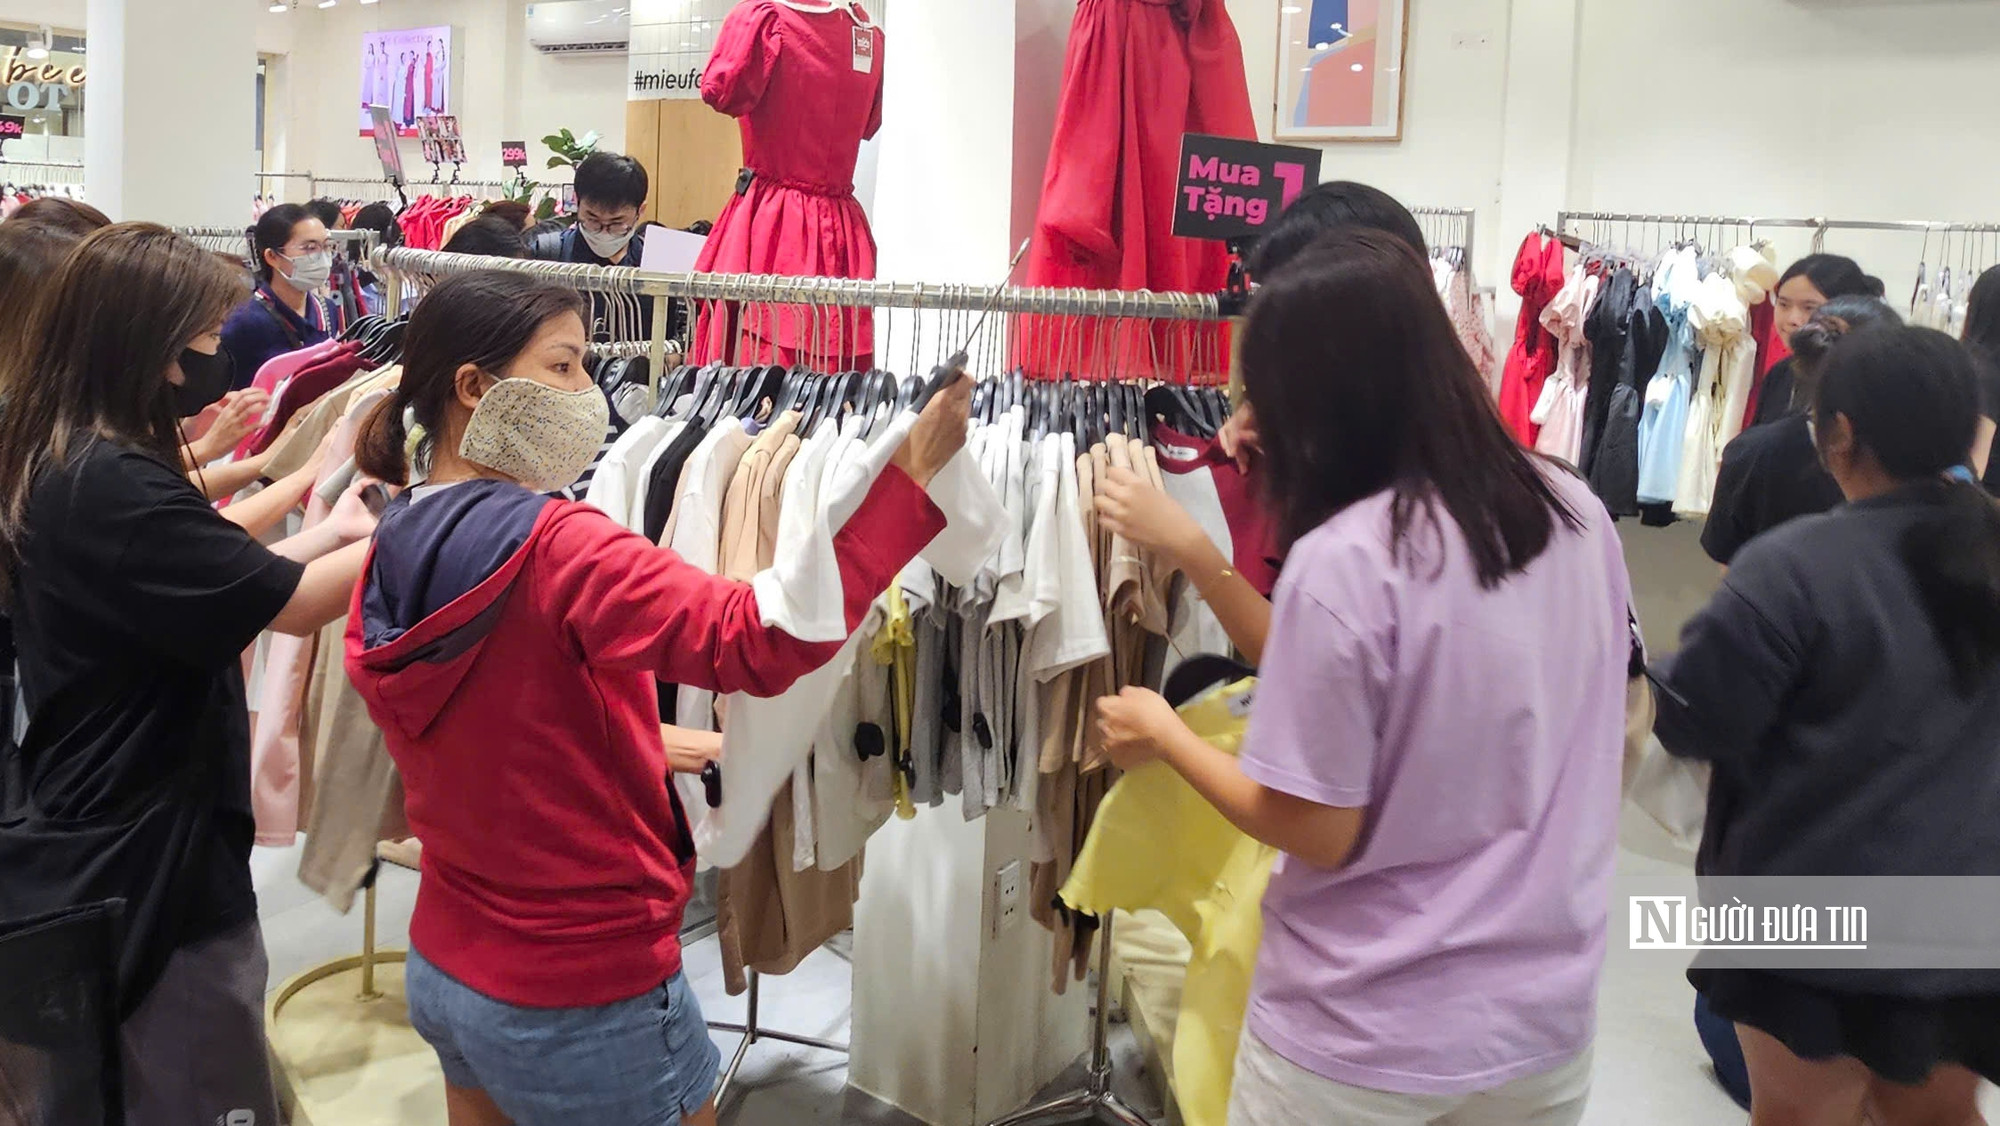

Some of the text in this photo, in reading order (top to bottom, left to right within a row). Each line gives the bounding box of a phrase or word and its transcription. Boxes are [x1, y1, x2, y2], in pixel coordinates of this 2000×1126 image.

[503, 147, 526, 160] 299k
[1188, 155, 1260, 186] Mua
[1183, 186, 1268, 225] Tặng
